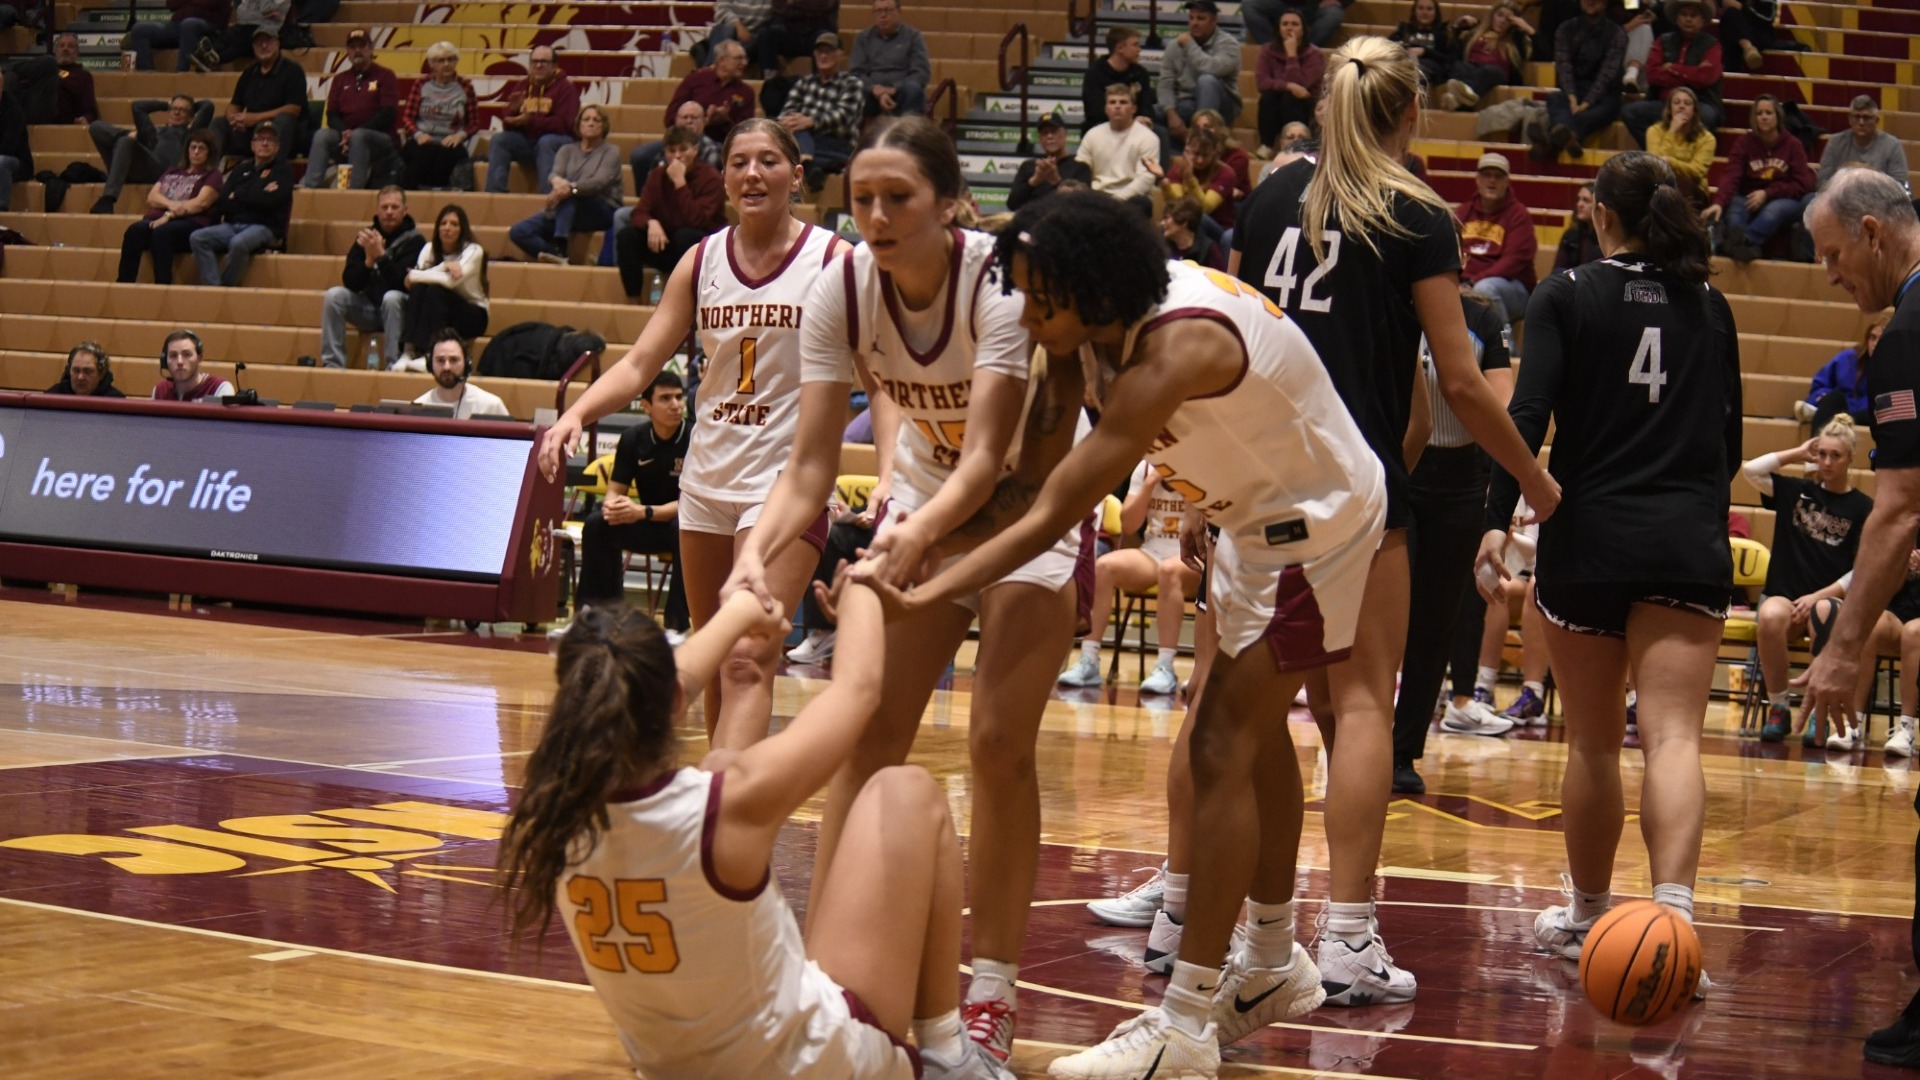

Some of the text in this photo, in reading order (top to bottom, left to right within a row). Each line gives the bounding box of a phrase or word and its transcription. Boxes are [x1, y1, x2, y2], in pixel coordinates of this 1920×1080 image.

[1264, 227, 1341, 313] 42
[736, 337, 758, 394] 1
[1628, 326, 1667, 403] 4
[713, 402, 770, 426] STATE
[31, 457, 252, 513] here for life
[210, 549, 259, 561] DAKTRONICS
[566, 873, 681, 974] 25
